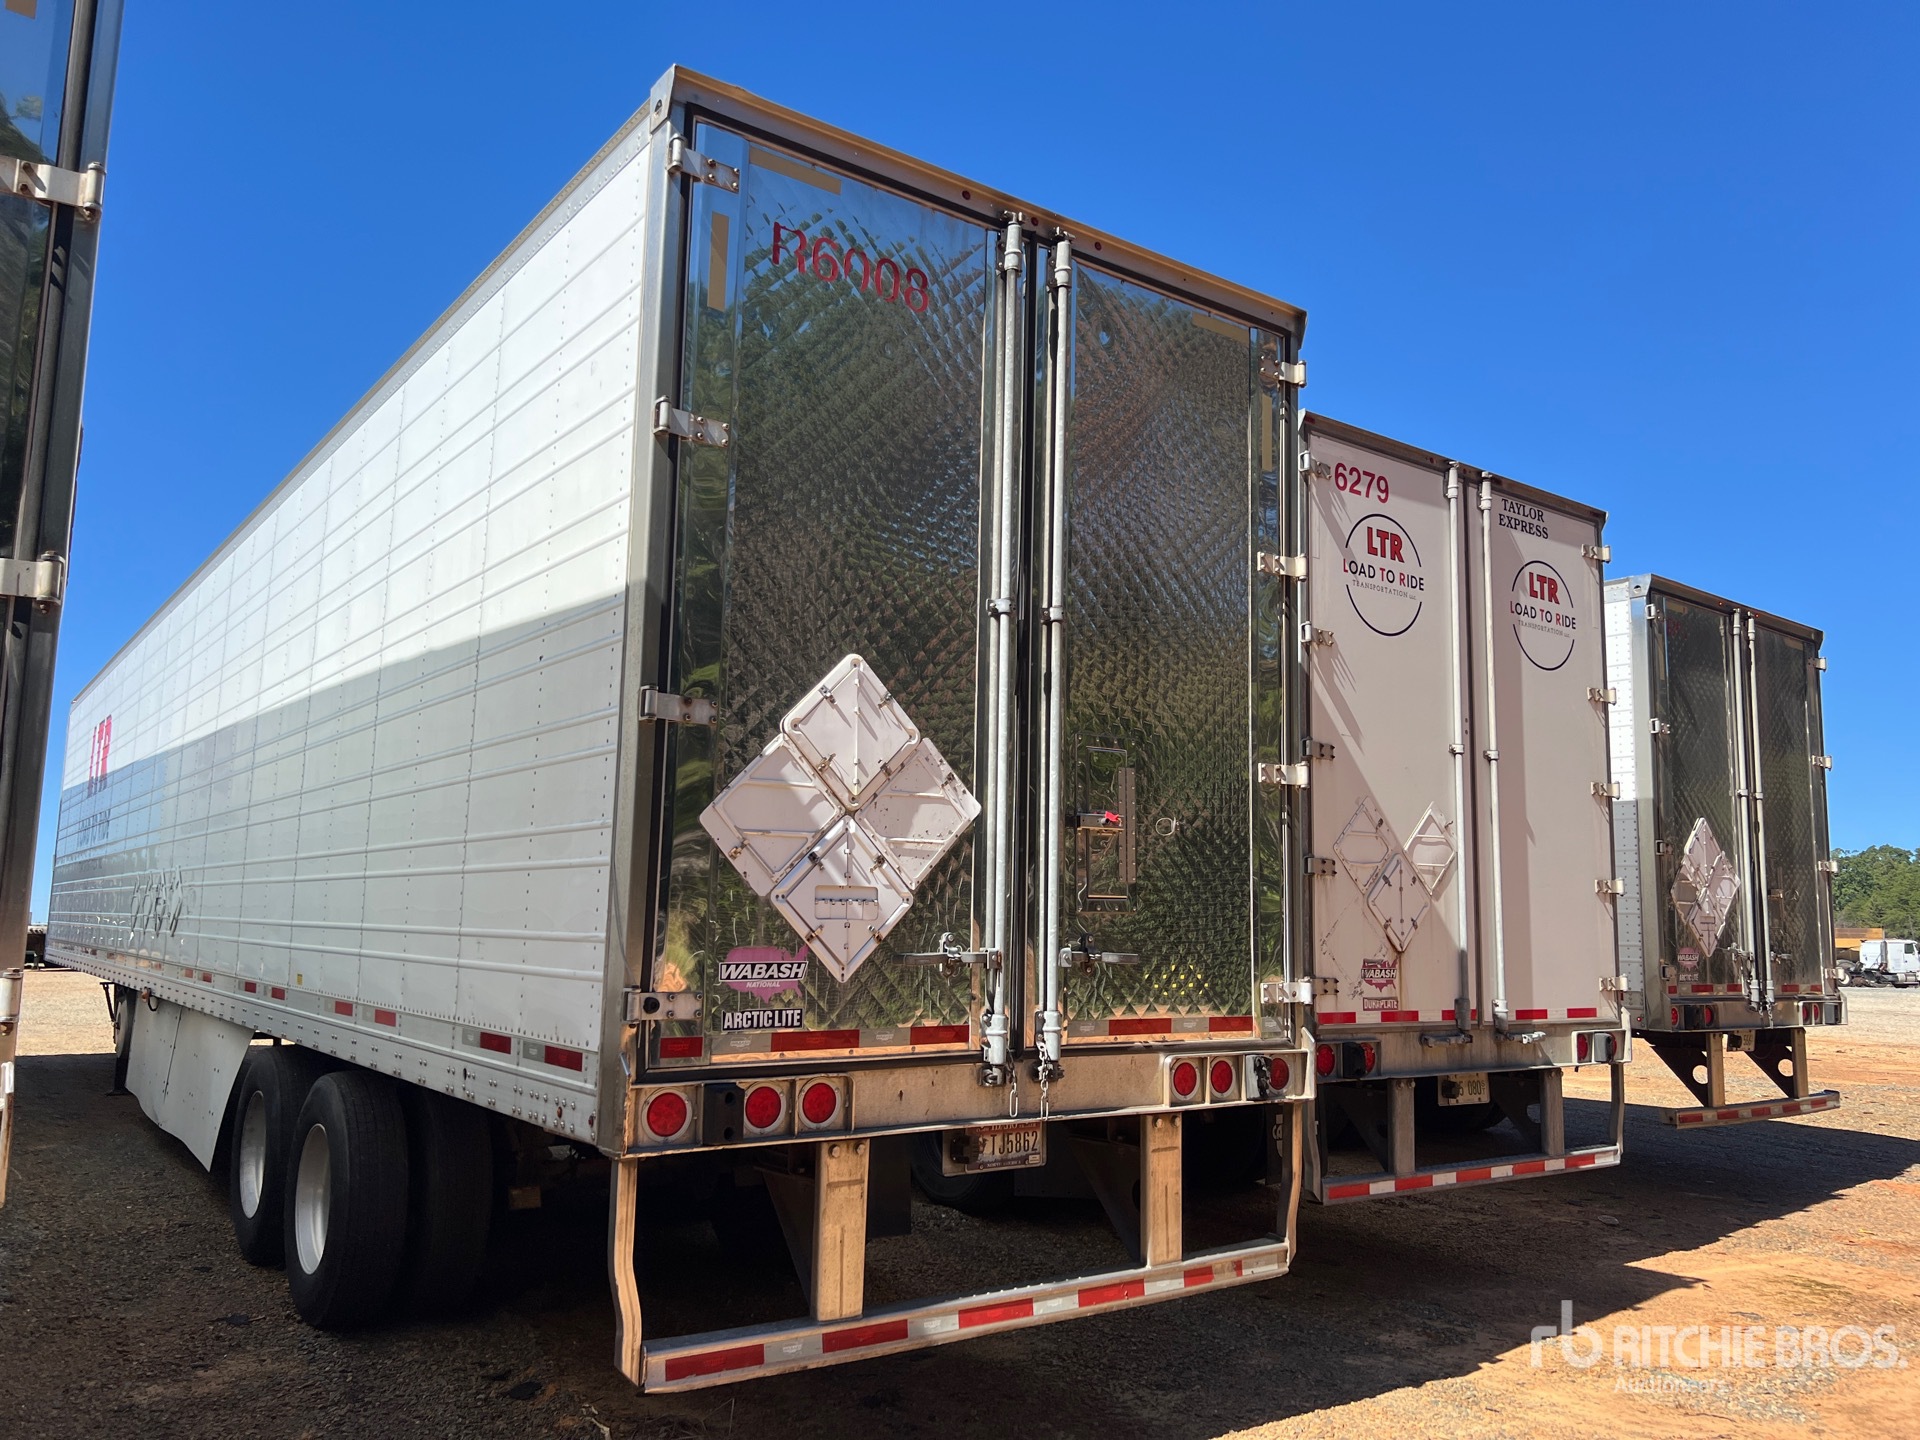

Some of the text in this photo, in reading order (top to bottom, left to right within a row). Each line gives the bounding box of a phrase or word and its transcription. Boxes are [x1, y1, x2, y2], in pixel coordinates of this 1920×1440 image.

[772, 221, 930, 313] R6008
[1334, 462, 1390, 504] 6279
[1501, 498, 1545, 523] TAYLOR
[1498, 513, 1549, 540] EXPRESS
[1366, 526, 1405, 563] LTR
[1343, 558, 1425, 591] LOAD TO RIDE
[1352, 579, 1408, 598] TRANSPORTATION
[1528, 571, 1560, 605] LTR
[1509, 600, 1577, 630] LOAD TO RIDE
[1518, 620, 1563, 636] TRANSPORTATION
[721, 963, 806, 980] WABASH
[723, 1009, 801, 1029] ARCTIC LITE
